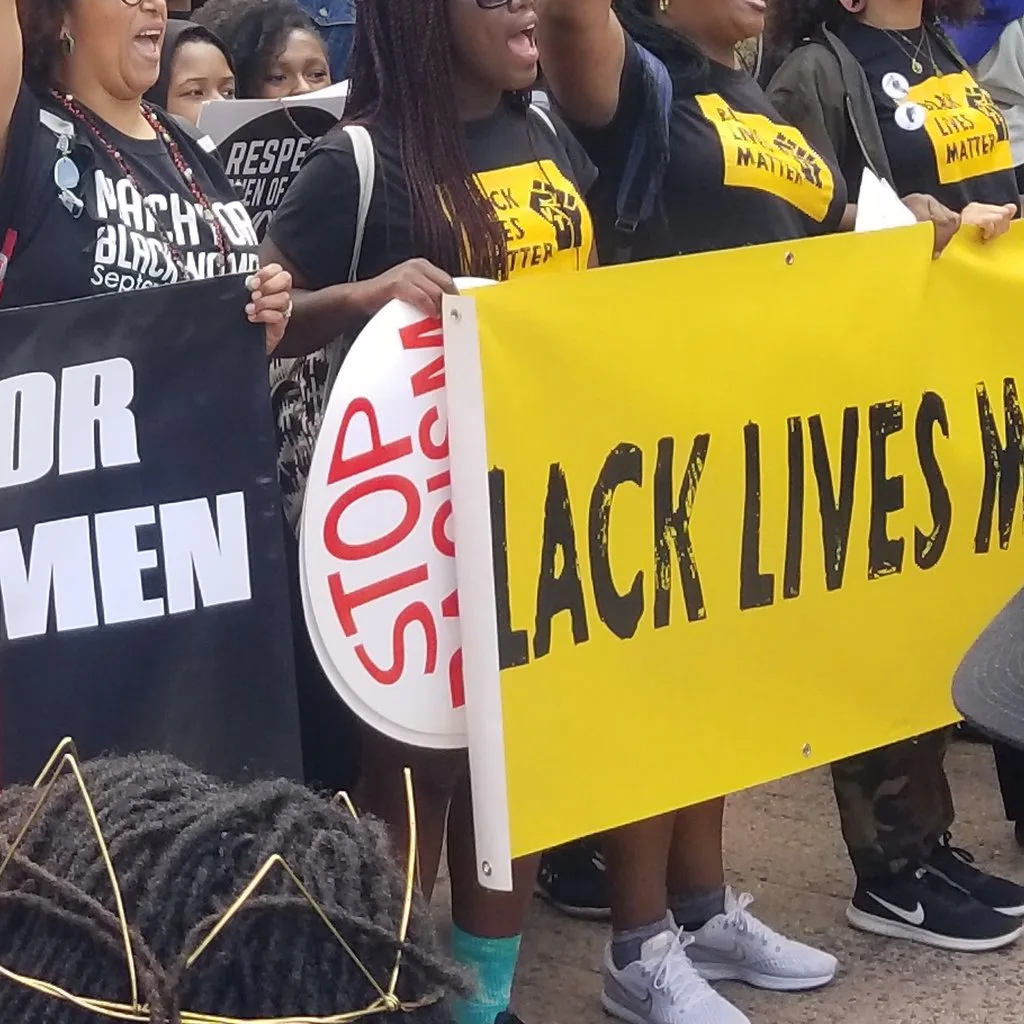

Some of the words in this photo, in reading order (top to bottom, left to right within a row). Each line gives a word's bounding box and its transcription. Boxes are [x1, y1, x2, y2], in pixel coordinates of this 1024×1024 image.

[946, 134, 996, 164] MATTER
[323, 396, 438, 688] STOP
[740, 390, 952, 611] LIVES
